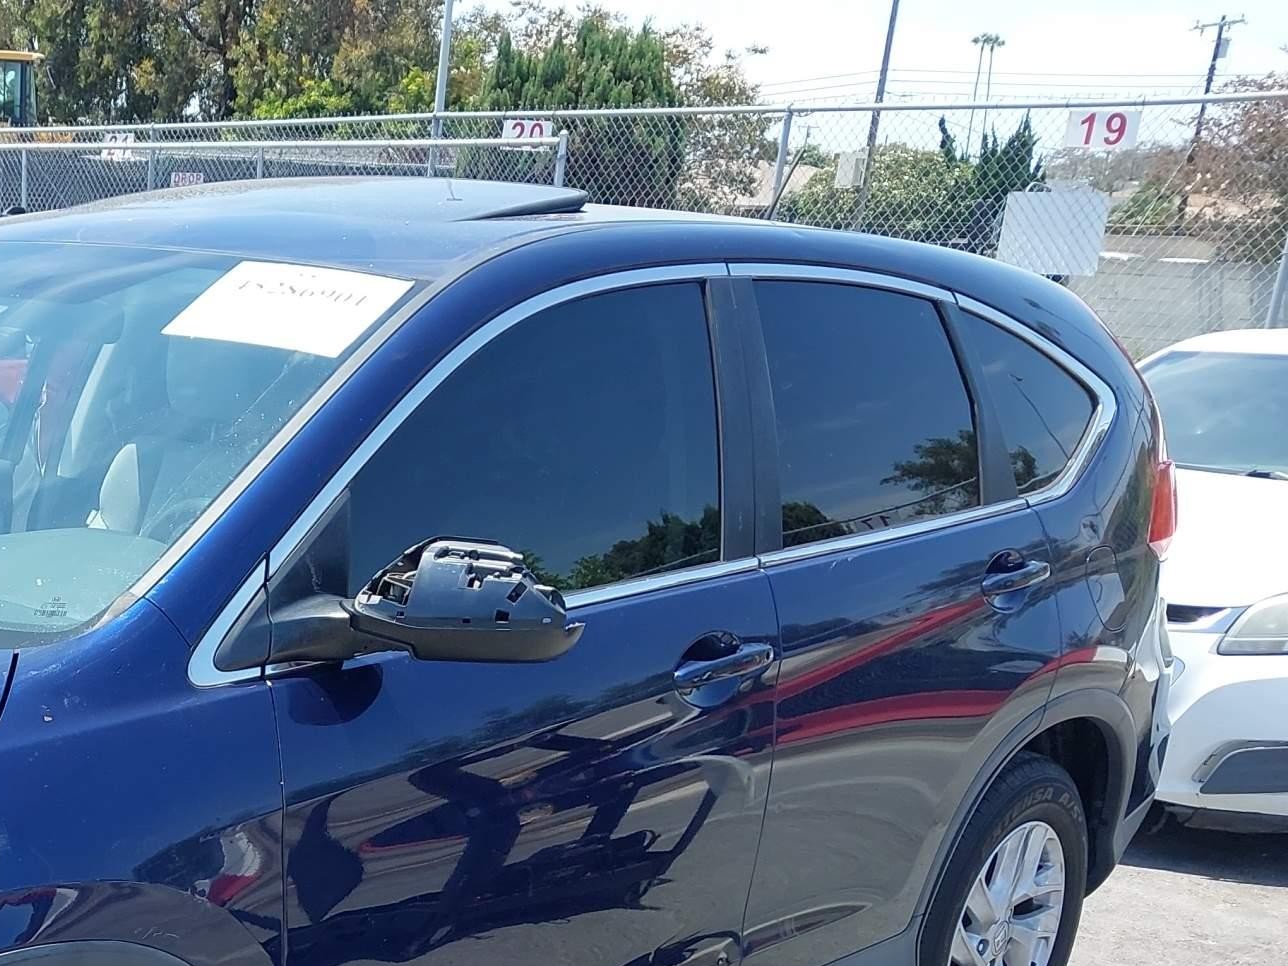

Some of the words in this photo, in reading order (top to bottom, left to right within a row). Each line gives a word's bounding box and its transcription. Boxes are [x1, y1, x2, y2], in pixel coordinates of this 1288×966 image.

[511, 121, 543, 139] 20
[1080, 112, 1128, 146] 19
[173, 173, 202, 186] DROP
